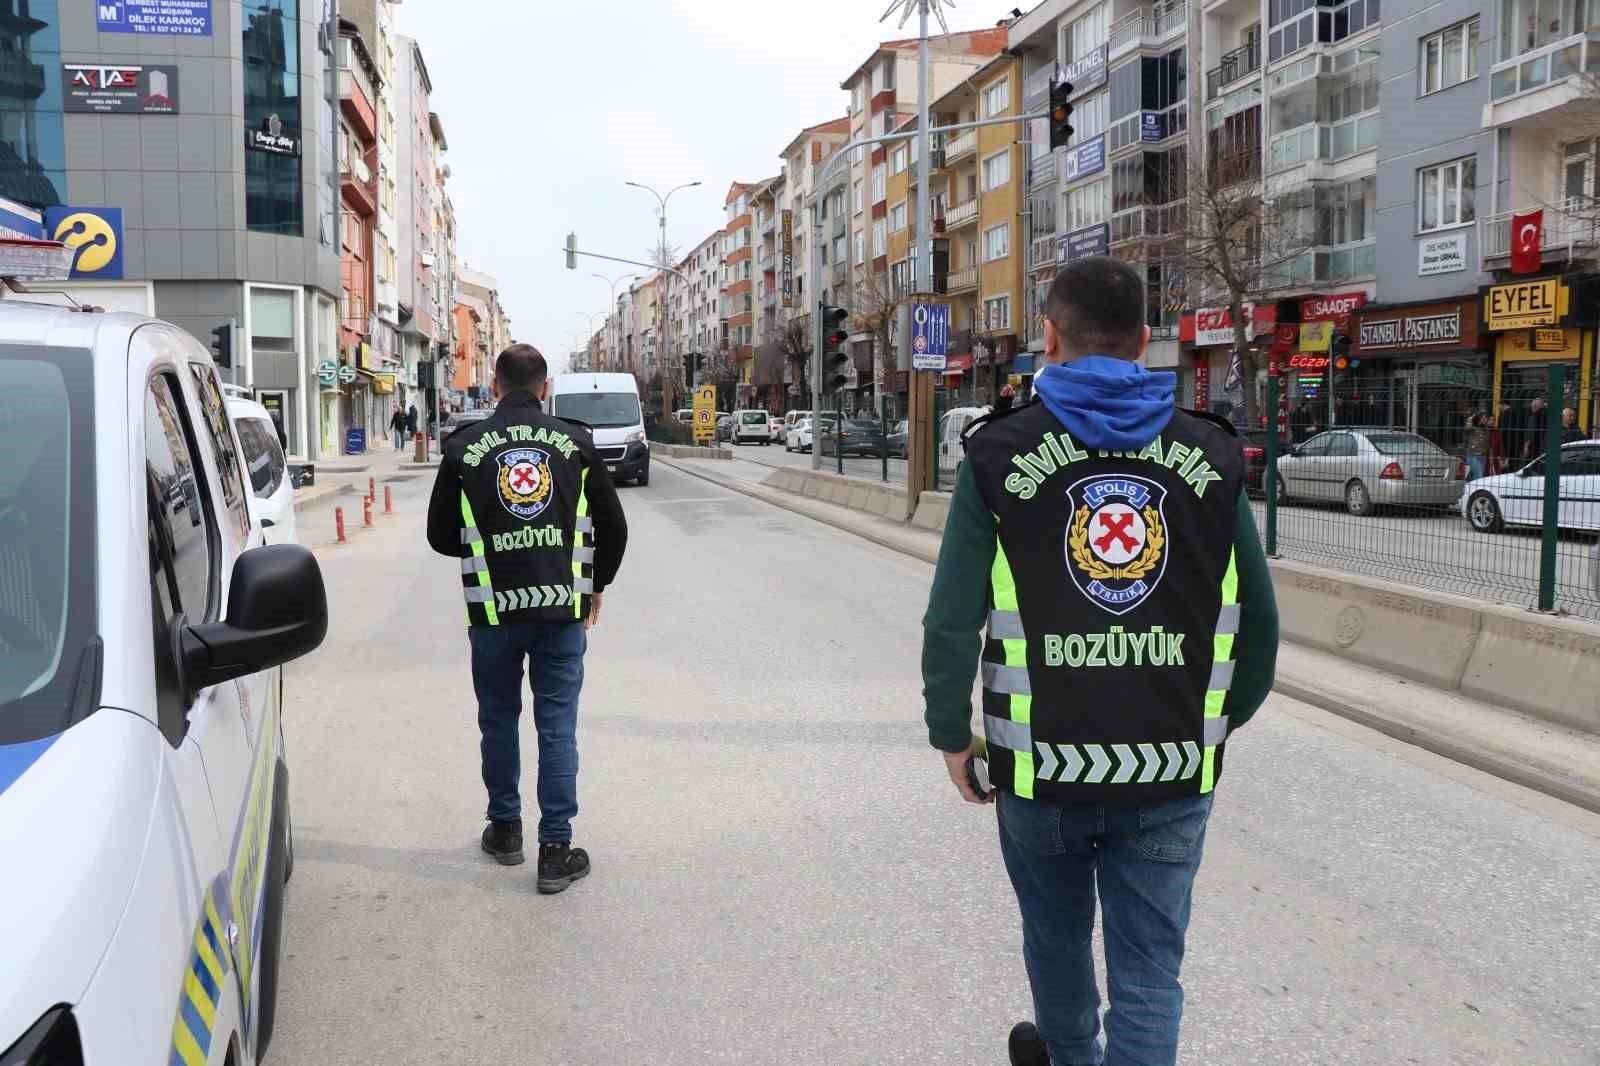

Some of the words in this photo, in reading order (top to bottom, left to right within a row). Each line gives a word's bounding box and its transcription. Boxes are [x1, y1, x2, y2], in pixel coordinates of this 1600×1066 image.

[129, 14, 157, 24] DİLEK
[159, 16, 206, 27] KARAKOÇ
[1315, 297, 1358, 316] SAADET
[1491, 284, 1553, 314] EYFEL
[462, 430, 508, 467] SİVİL
[506, 424, 580, 460] TRAFİK
[1004, 431, 1089, 500] SİVİL
[1099, 434, 1223, 499] AFİK
[1043, 625, 1186, 668] BOZÜYÜK
